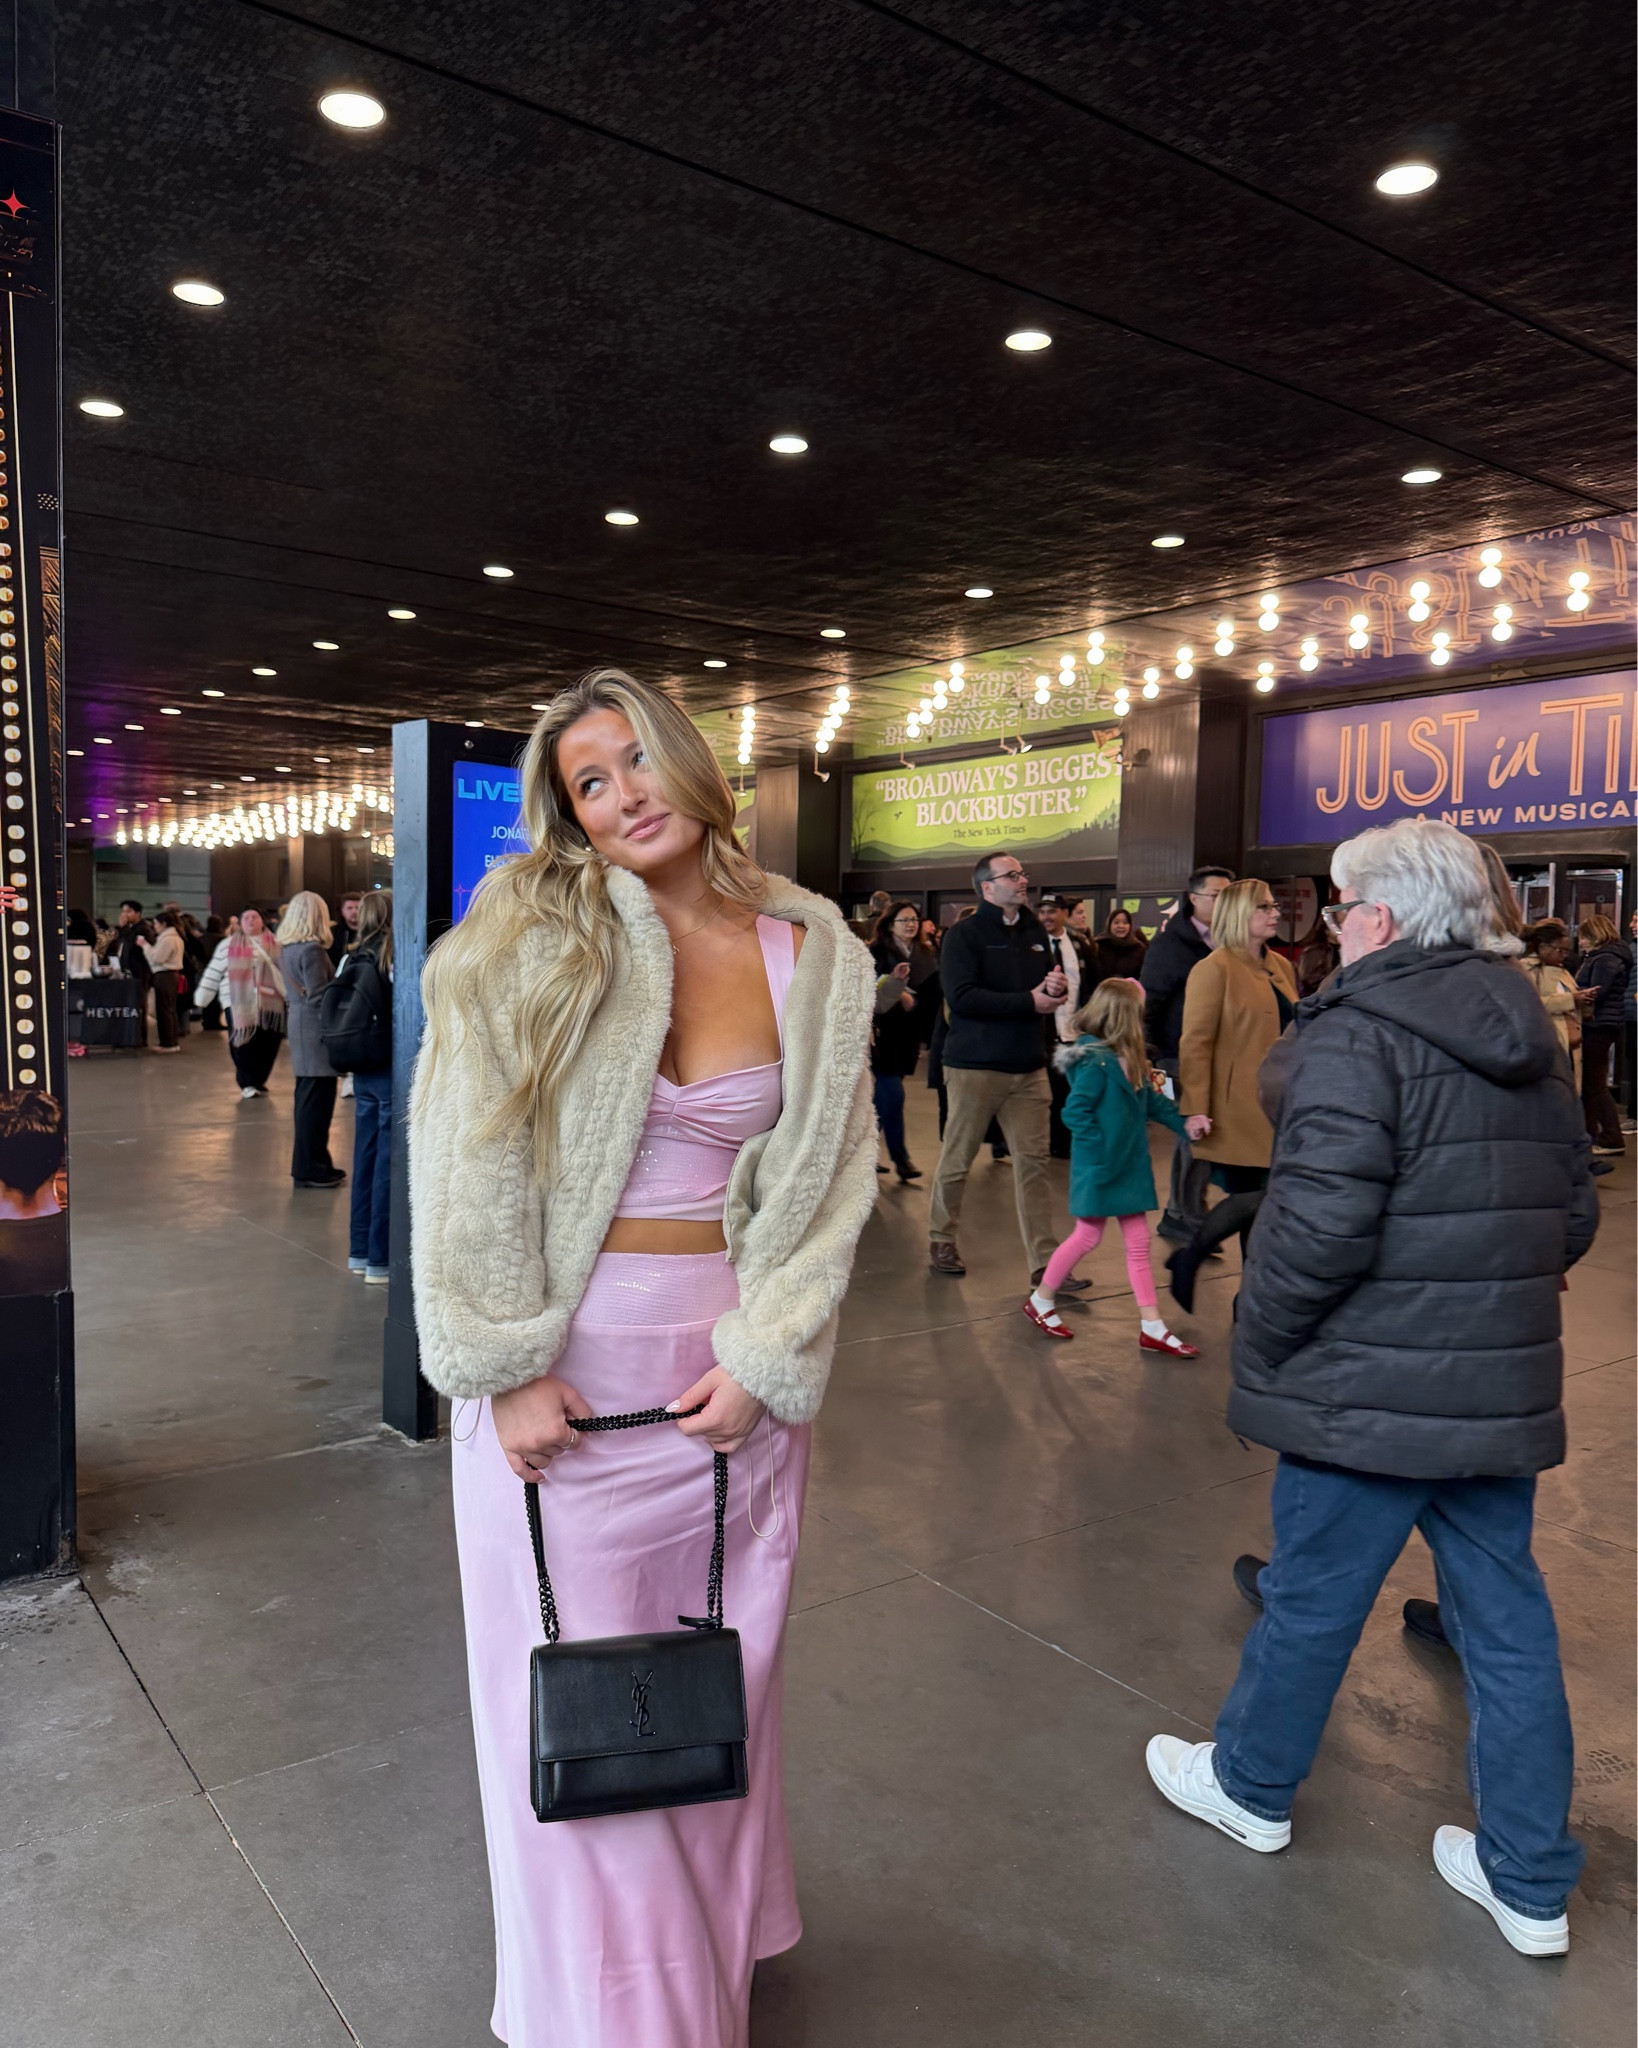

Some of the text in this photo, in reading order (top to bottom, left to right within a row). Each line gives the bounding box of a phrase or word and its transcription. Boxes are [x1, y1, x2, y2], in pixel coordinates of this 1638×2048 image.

[1316, 690, 1637, 814] JUST in TI
[457, 778, 524, 803] LIVE
[1441, 807, 1503, 827] NEW
[953, 825, 1026, 838] The New York Times
[86, 1006, 139, 1018] HEYTEA
